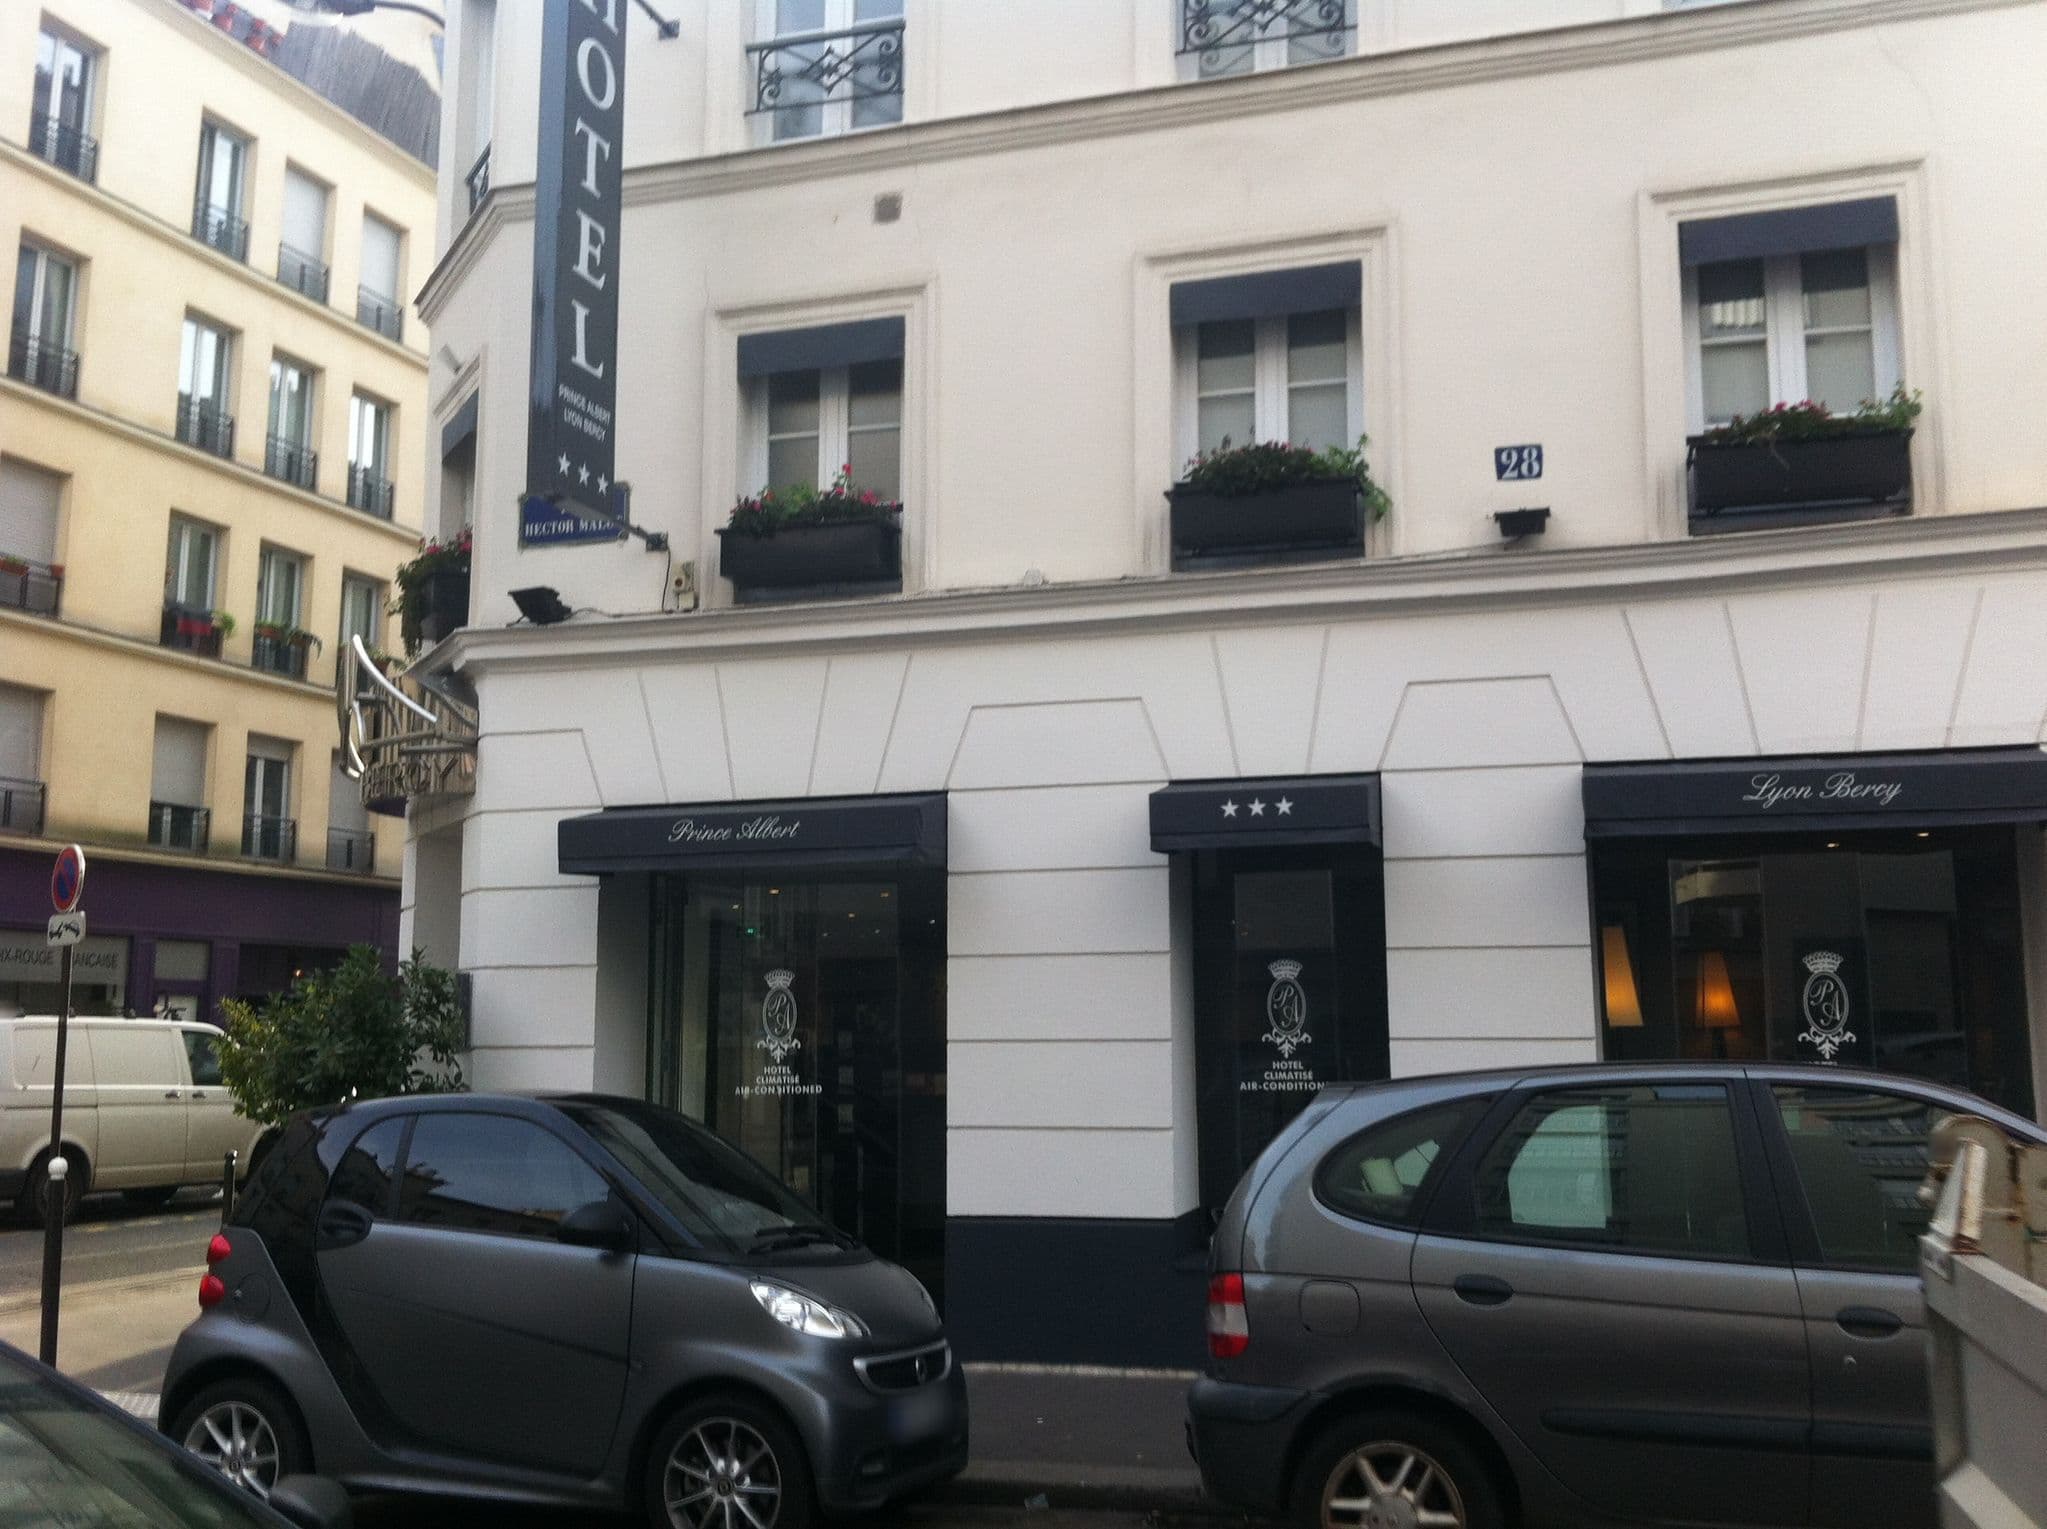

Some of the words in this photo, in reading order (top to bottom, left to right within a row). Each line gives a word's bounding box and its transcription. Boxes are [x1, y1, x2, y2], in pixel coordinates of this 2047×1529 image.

[564, 406, 583, 429] LYON
[1500, 446, 1540, 479] 28
[525, 520, 574, 537] HECTOR
[579, 514, 623, 532] MALO
[1742, 773, 1813, 809] Lyon
[1819, 772, 1902, 806] Bercy
[668, 818, 732, 841] Prince
[736, 816, 800, 840] Albert
[763, 1066, 791, 1075] HOTEL
[1272, 1061, 1304, 1070] HOTEL
